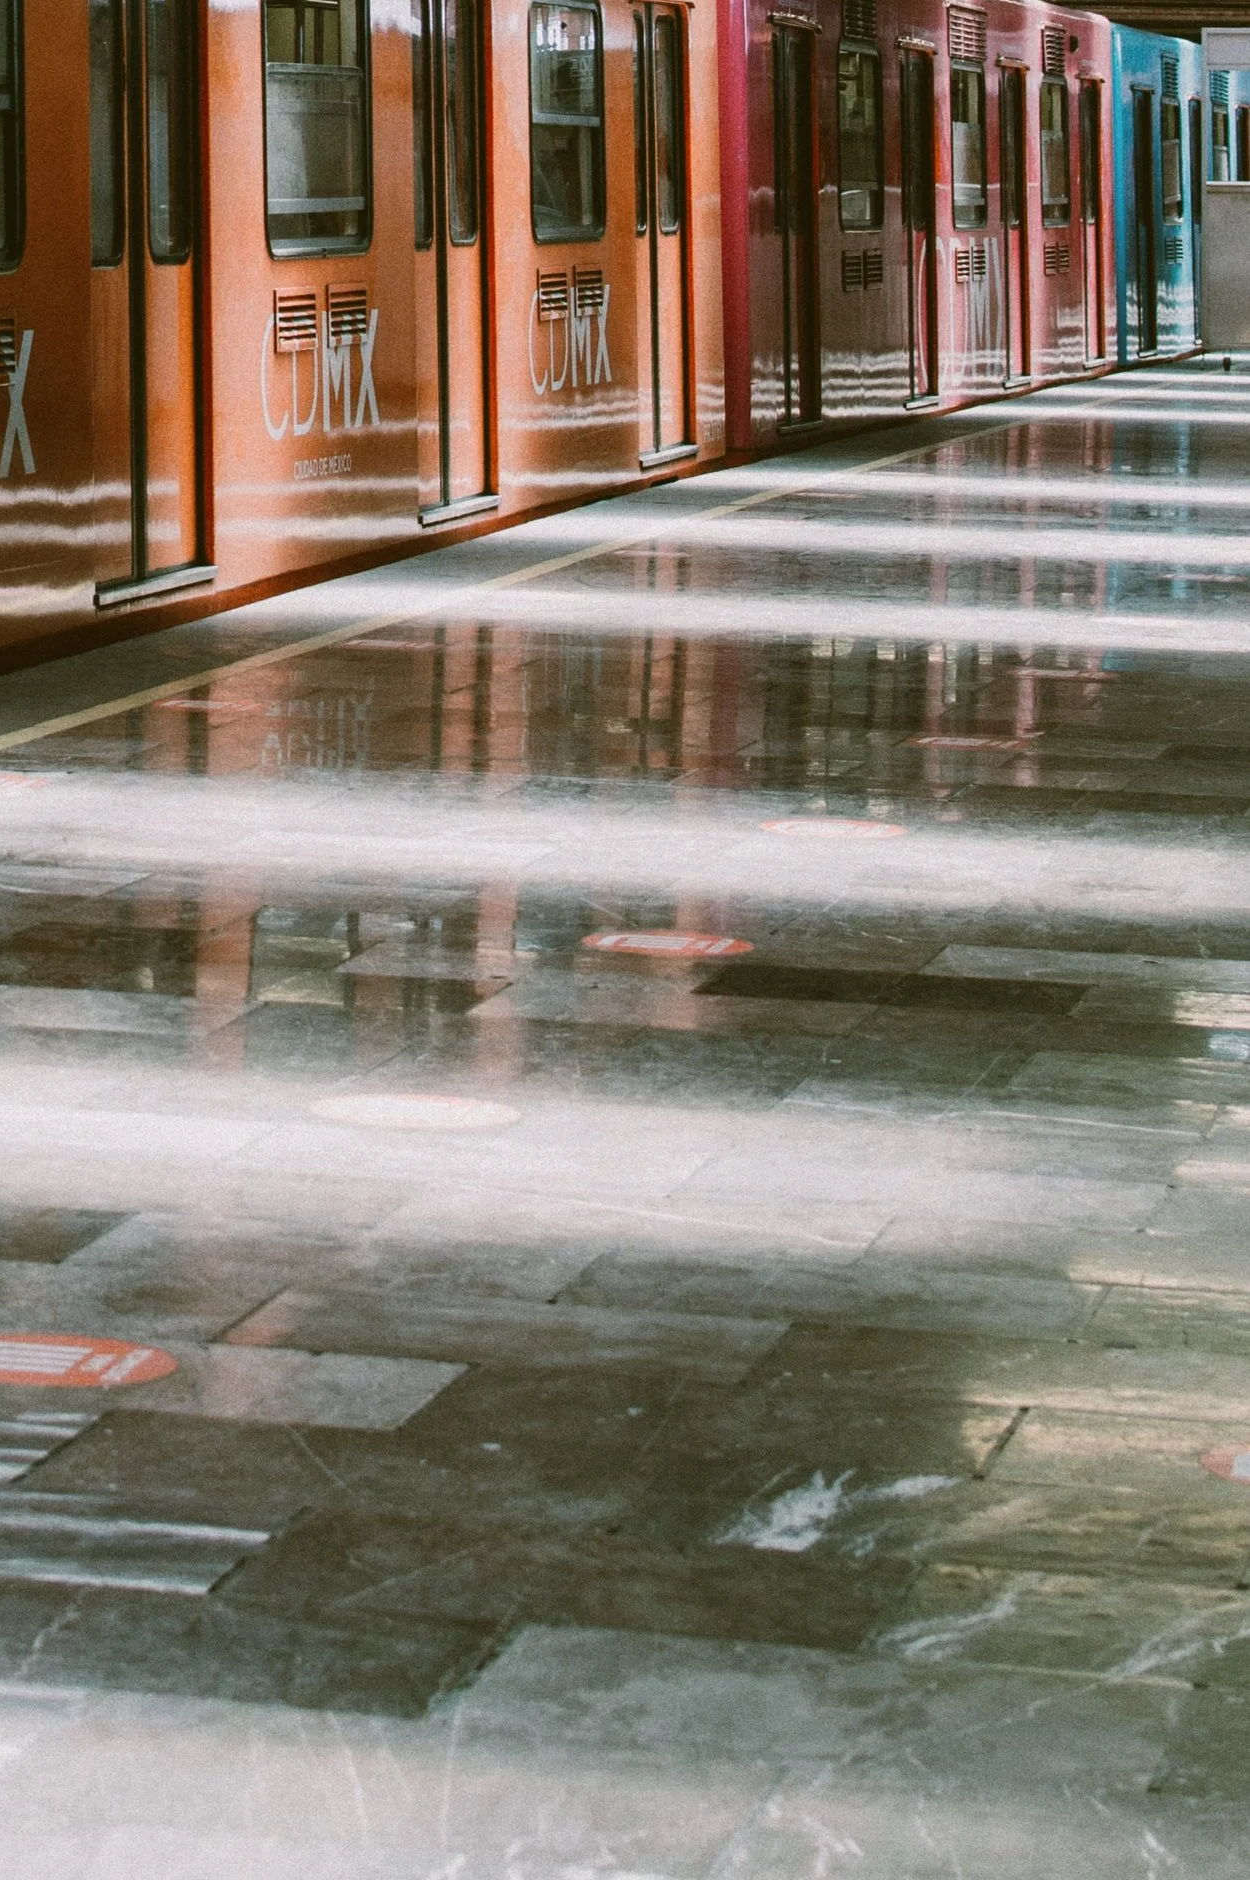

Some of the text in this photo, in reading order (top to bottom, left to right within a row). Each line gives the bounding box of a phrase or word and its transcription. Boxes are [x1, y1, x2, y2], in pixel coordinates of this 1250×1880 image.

[261, 308, 381, 441] CDMX
[528, 283, 613, 396] CDMX
[294, 459, 318, 481] CIUDAD
[319, 456, 328, 476] DE
